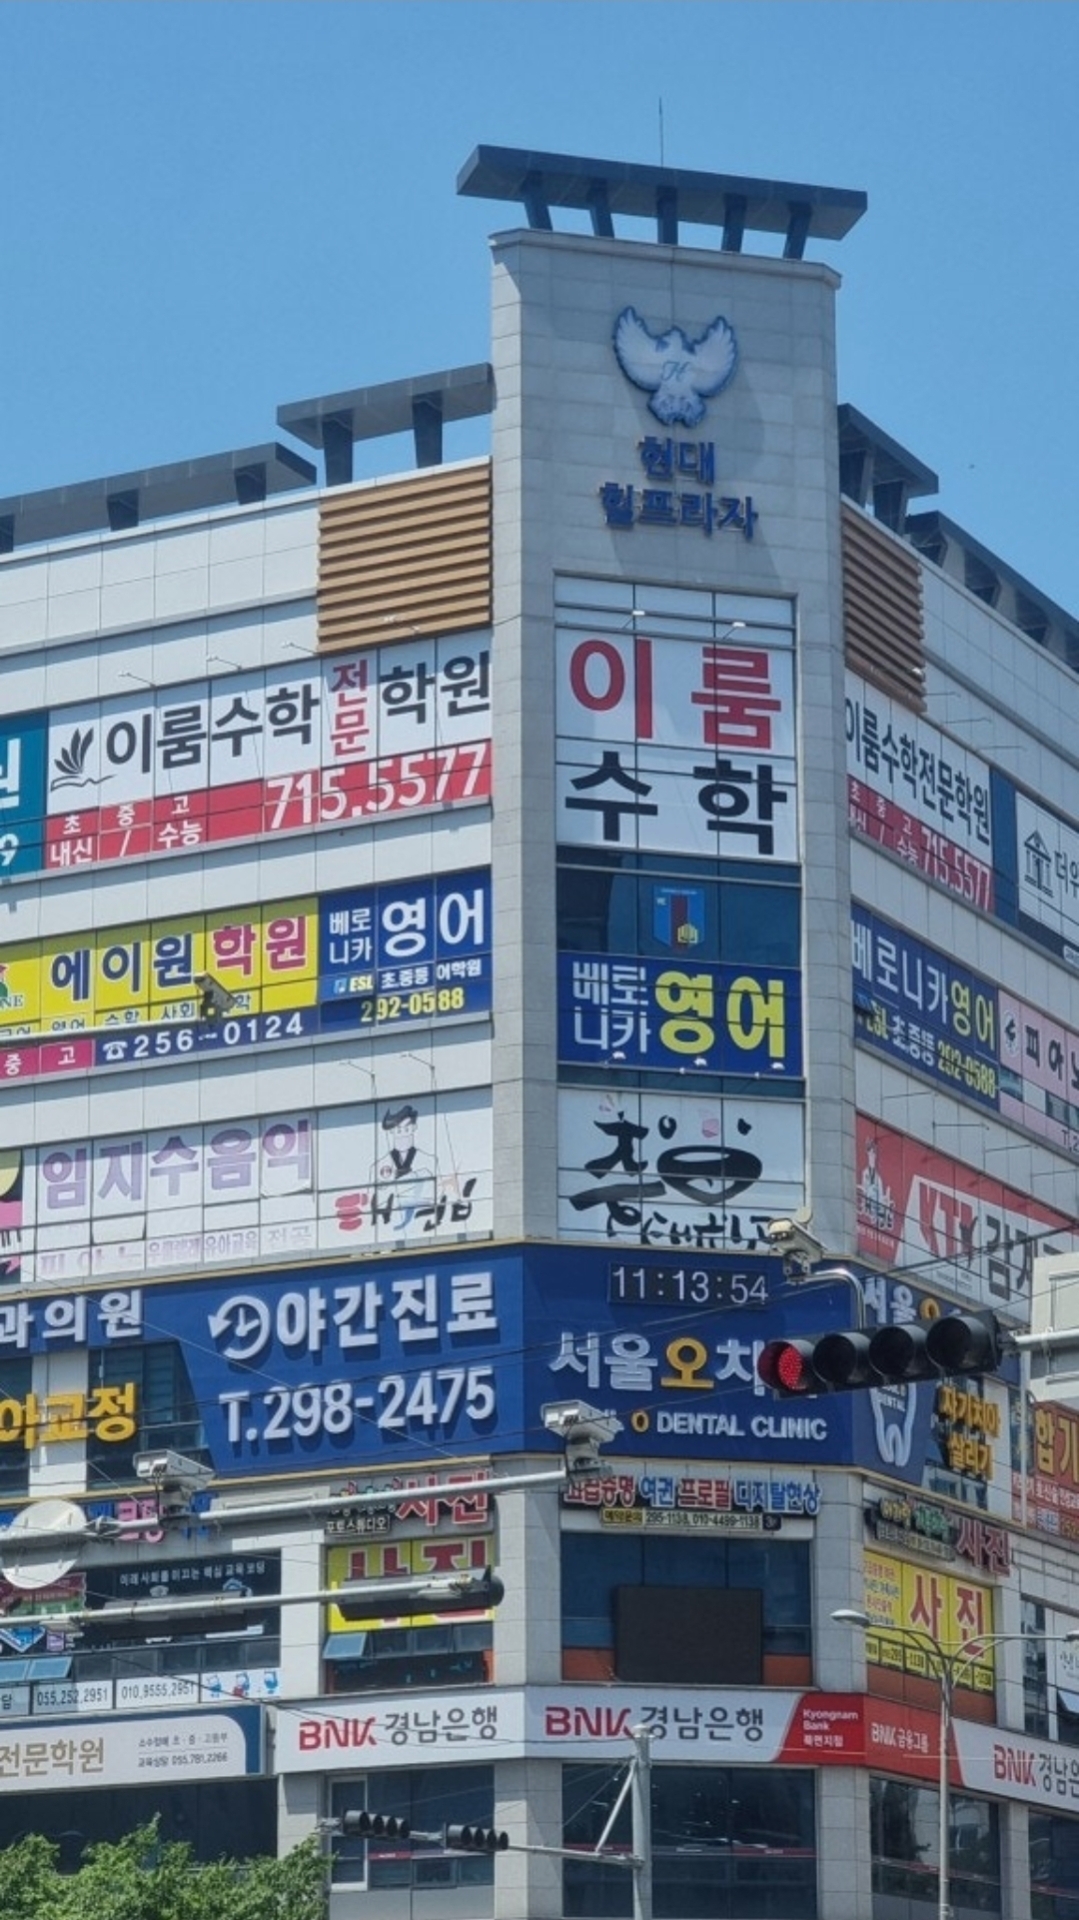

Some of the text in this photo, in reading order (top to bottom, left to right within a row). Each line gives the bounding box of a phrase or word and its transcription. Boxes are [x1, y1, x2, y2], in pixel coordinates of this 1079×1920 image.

[640, 437, 715, 486] 현대
[570, 638, 782, 750] 이룸
[268, 742, 488, 828] 715.5577
[566, 750, 787, 855] 수학
[63, 796, 190, 835] 초 중 고
[51, 836, 93, 866] 내신
[158, 820, 203, 850] 수능
[921, 826, 989, 912] 715.5577
[329, 889, 485, 957] 베로 영어
[52, 916, 307, 1001] 에이원 학원
[329, 936, 373, 964] 니카
[361, 987, 464, 1022] 292-0588
[573, 961, 785, 1058] 베로 영어
[133, 1012, 304, 1058] 256-0124
[574, 1006, 652, 1053] 니카
[57, 1046, 75, 1065] 고
[612, 1266, 769, 1304] 11:13:54
[0, 1289, 142, 1349] 과의원
[276, 1273, 497, 1351] 야간진료
[219, 1366, 495, 1442] T.298-2475
[657, 1413, 746, 1438] DENTAL
[751, 1416, 827, 1440] CLINIC
[640, 1476, 677, 1508] 여권
[678, 1479, 733, 1510] 프로필
[735, 1480, 822, 1515] 디지털현상
[957, 1518, 1011, 1577] 사진
[385, 1706, 498, 1746] 경남은행
[641, 1706, 765, 1744] 경남은행
[803, 1708, 858, 1720] Kyongnam
[803, 1721, 830, 1731] Bank
[0, 1737, 104, 1779] 전문학원
